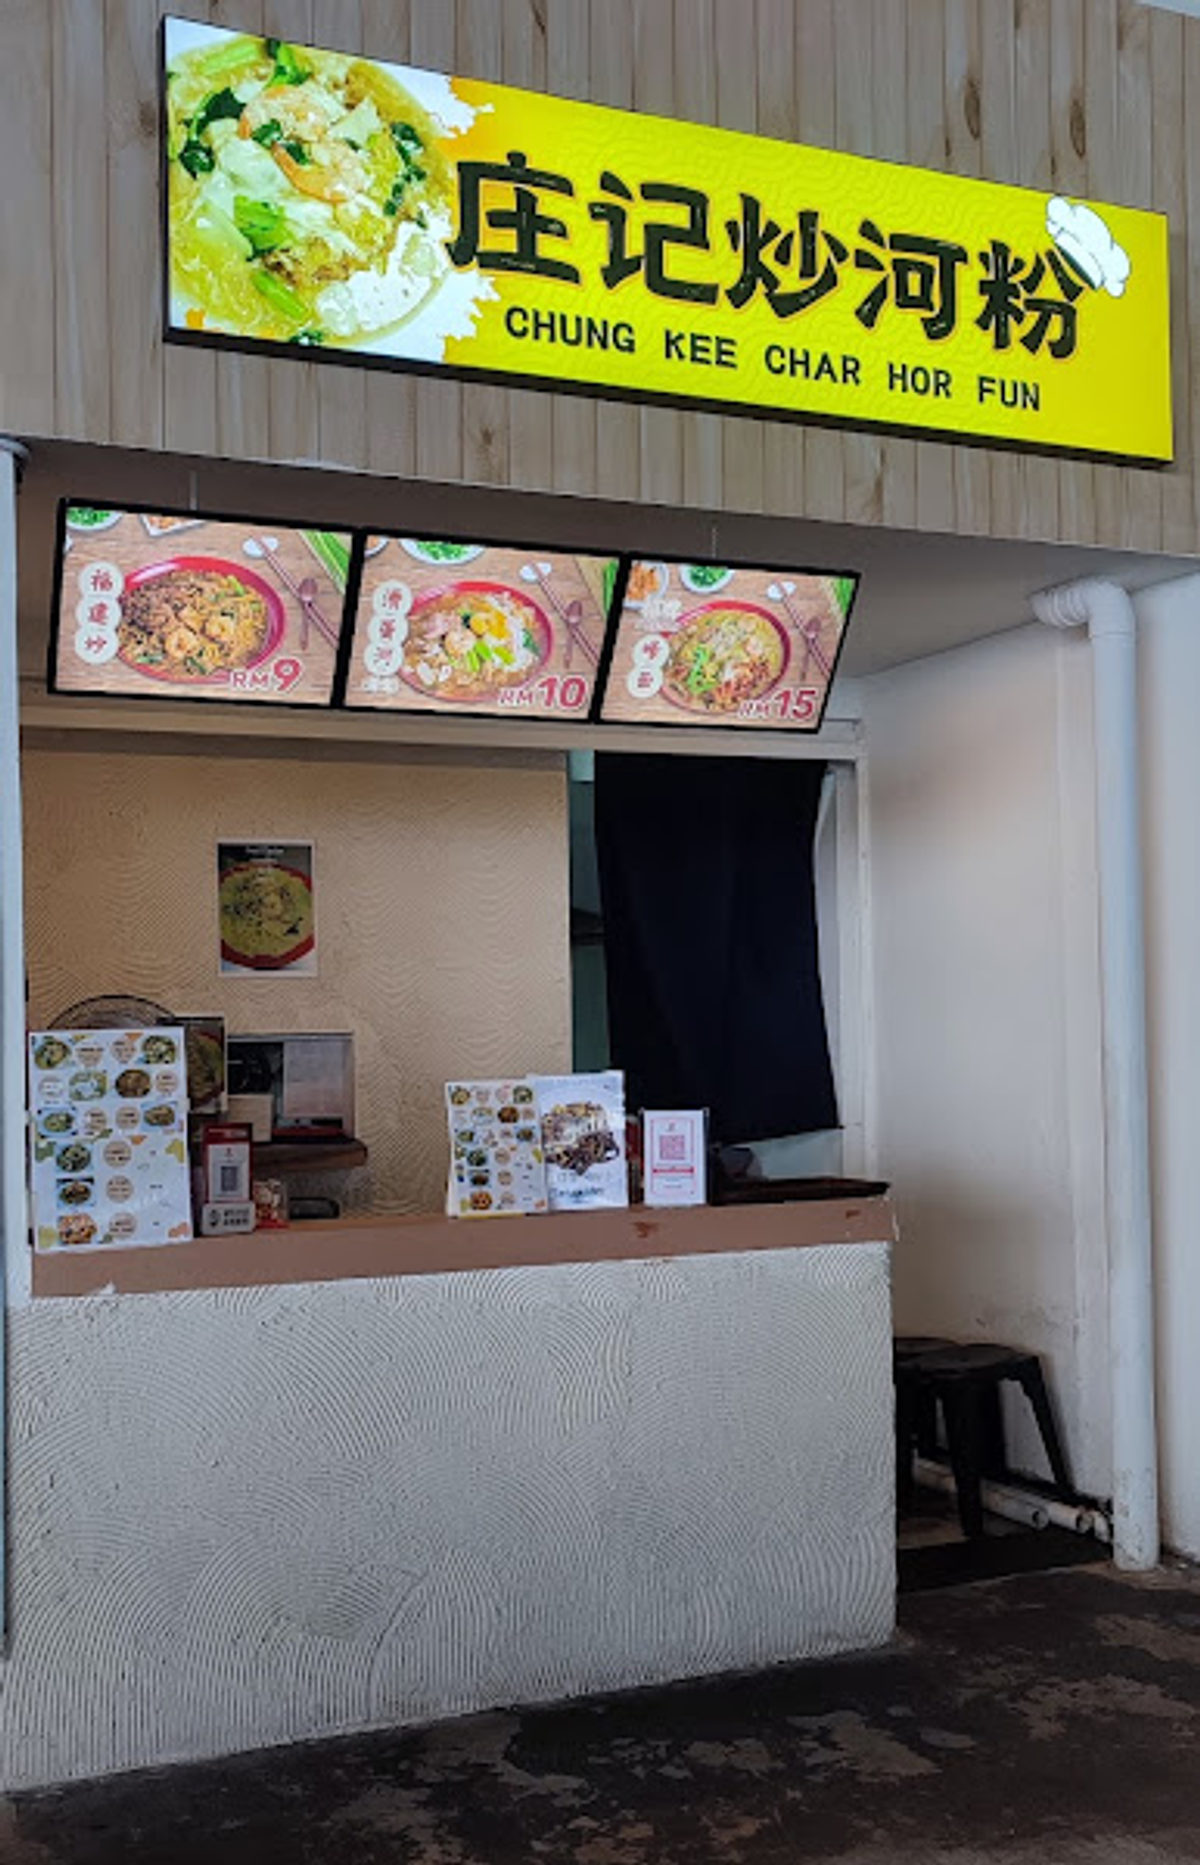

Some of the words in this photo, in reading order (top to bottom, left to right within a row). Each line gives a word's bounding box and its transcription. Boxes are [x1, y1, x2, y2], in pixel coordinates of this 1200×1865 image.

[445, 151, 1086, 359] 庄记炒河粉
[505, 306, 636, 354] CHUNG
[664, 329, 738, 370] KEE
[764, 345, 861, 386] CHAR
[888, 362, 951, 399] HOR
[978, 376, 1041, 412] FUN
